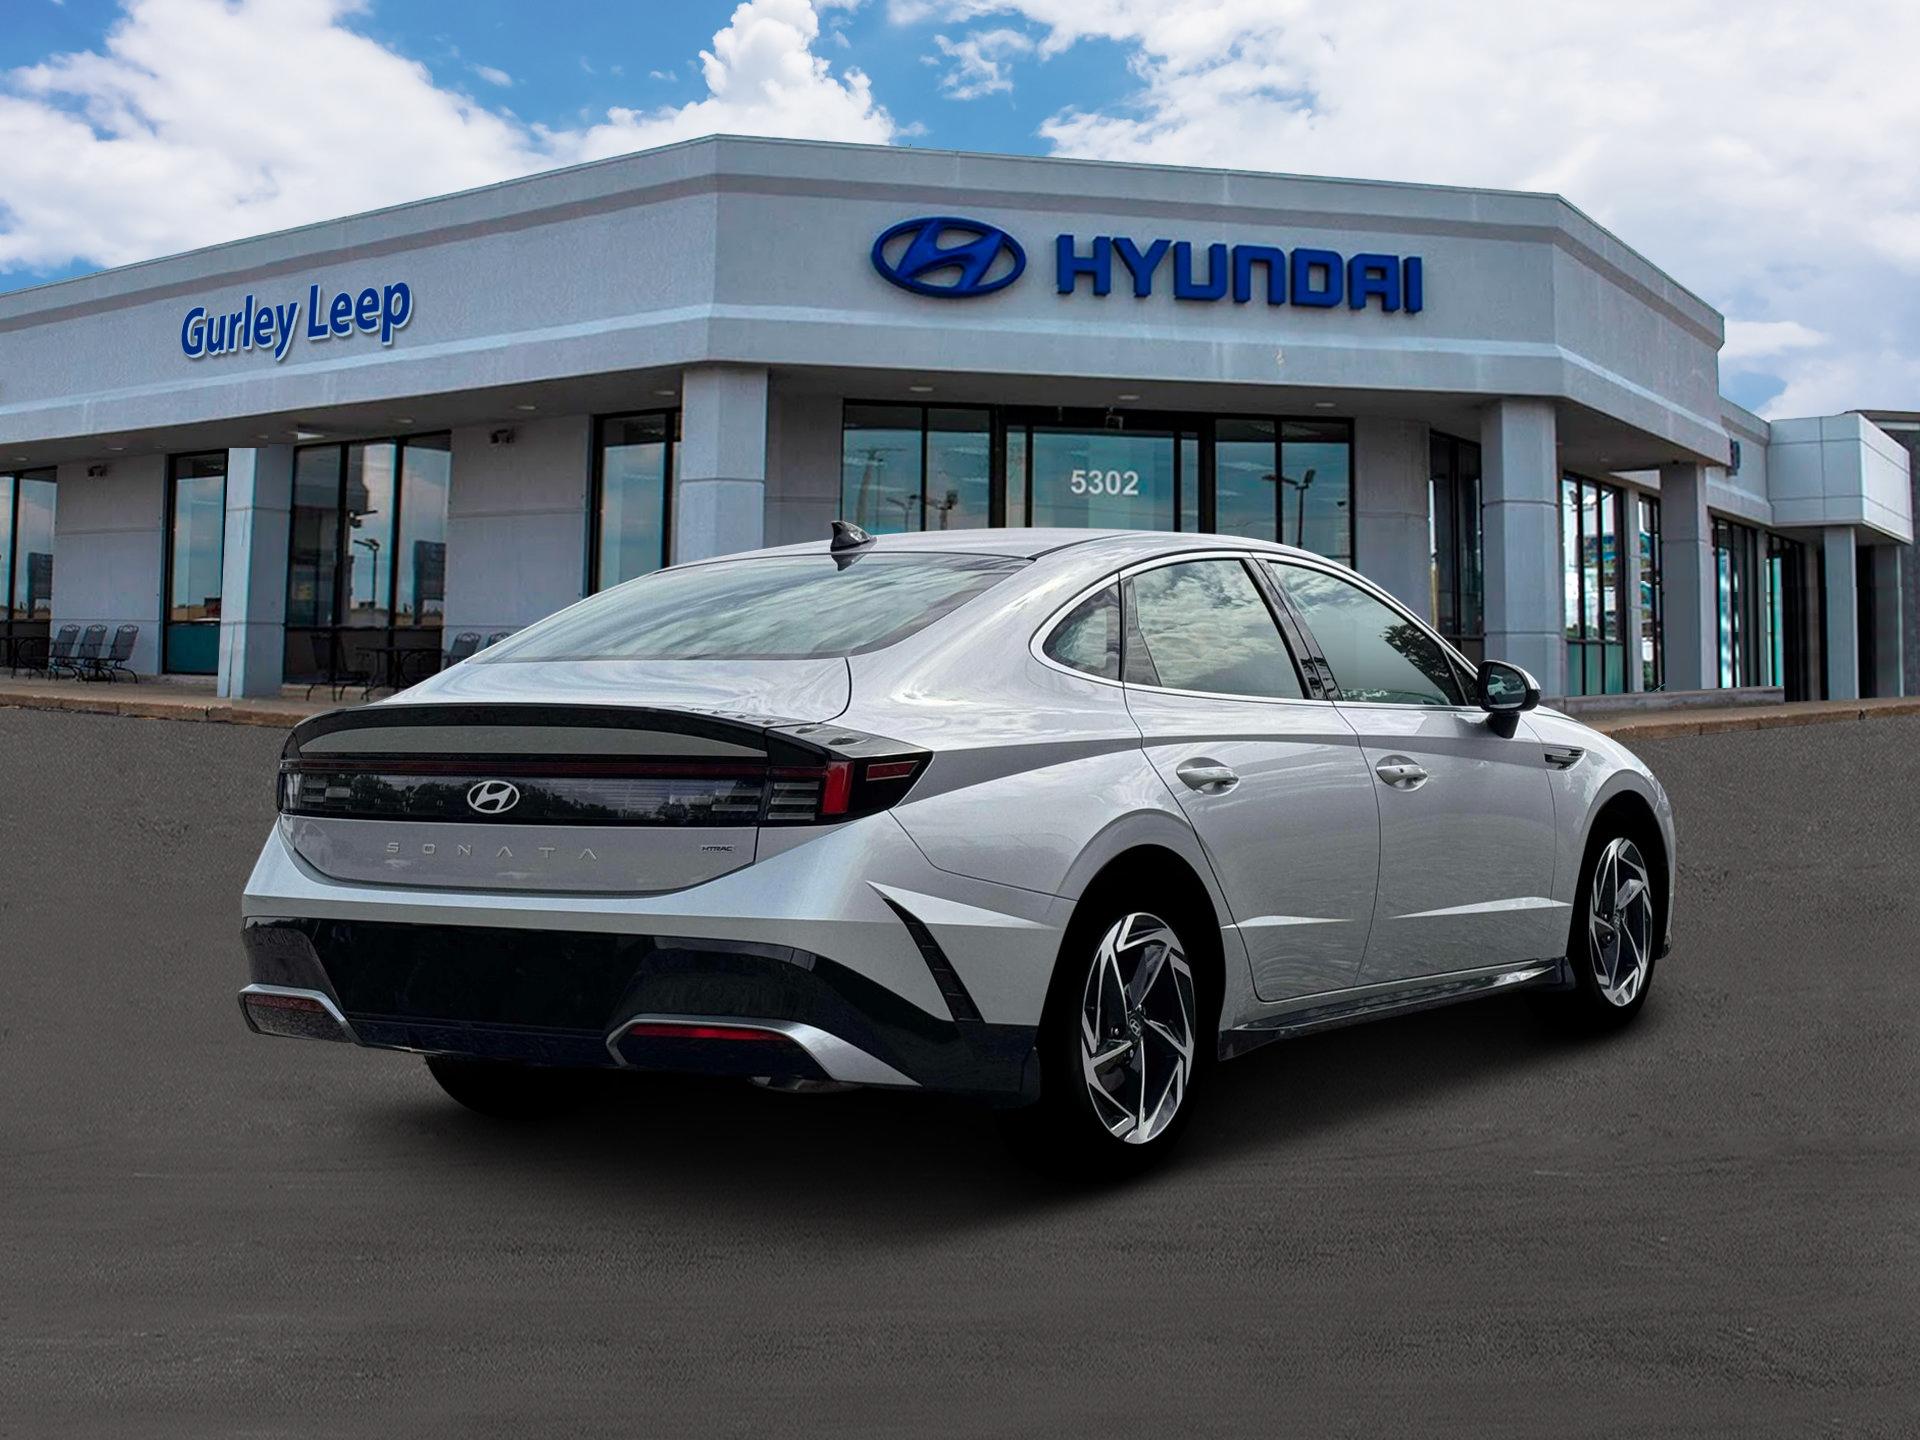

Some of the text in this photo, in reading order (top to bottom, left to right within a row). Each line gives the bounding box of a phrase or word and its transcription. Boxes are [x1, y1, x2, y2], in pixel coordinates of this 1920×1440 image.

[1056, 233, 1423, 314] HYUNDAI
[181, 281, 413, 361] Gurley Leep
[1070, 469, 1139, 495] 5302
[386, 842, 598, 861] SONATA
